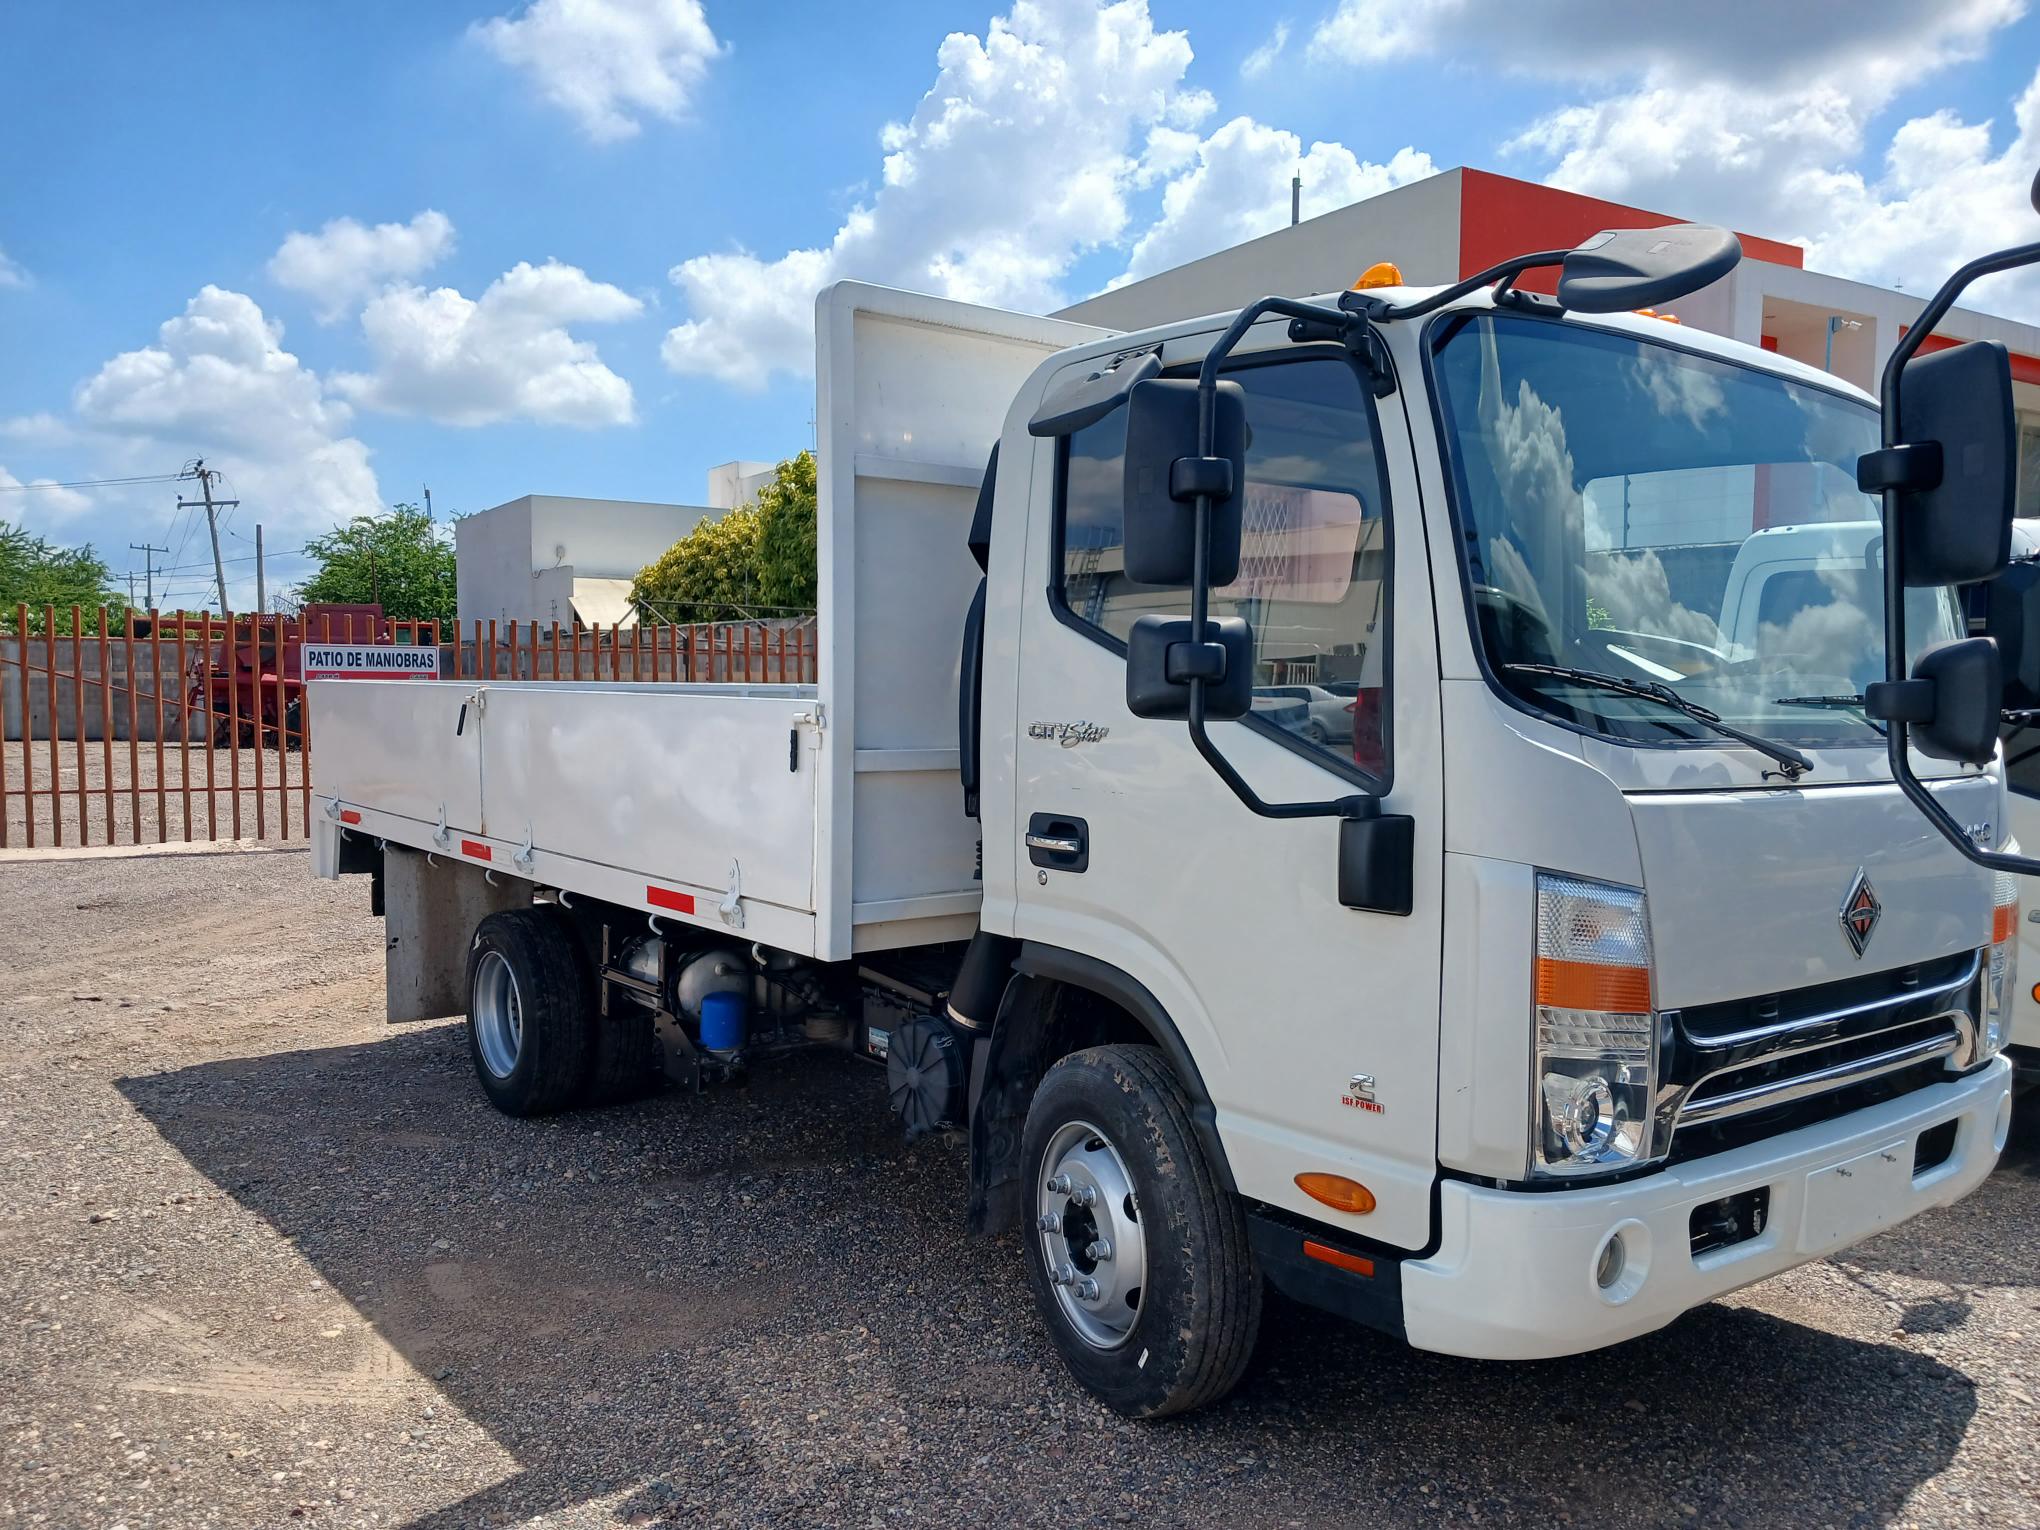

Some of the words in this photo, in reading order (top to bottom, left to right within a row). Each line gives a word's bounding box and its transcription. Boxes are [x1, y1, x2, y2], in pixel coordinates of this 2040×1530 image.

[309, 651, 343, 666] PATIO
[347, 652, 362, 667] DE
[366, 653, 434, 668] MANIOBRAS
[1342, 1096, 1353, 1106] ISF
[1355, 1099, 1382, 1113] POWER
